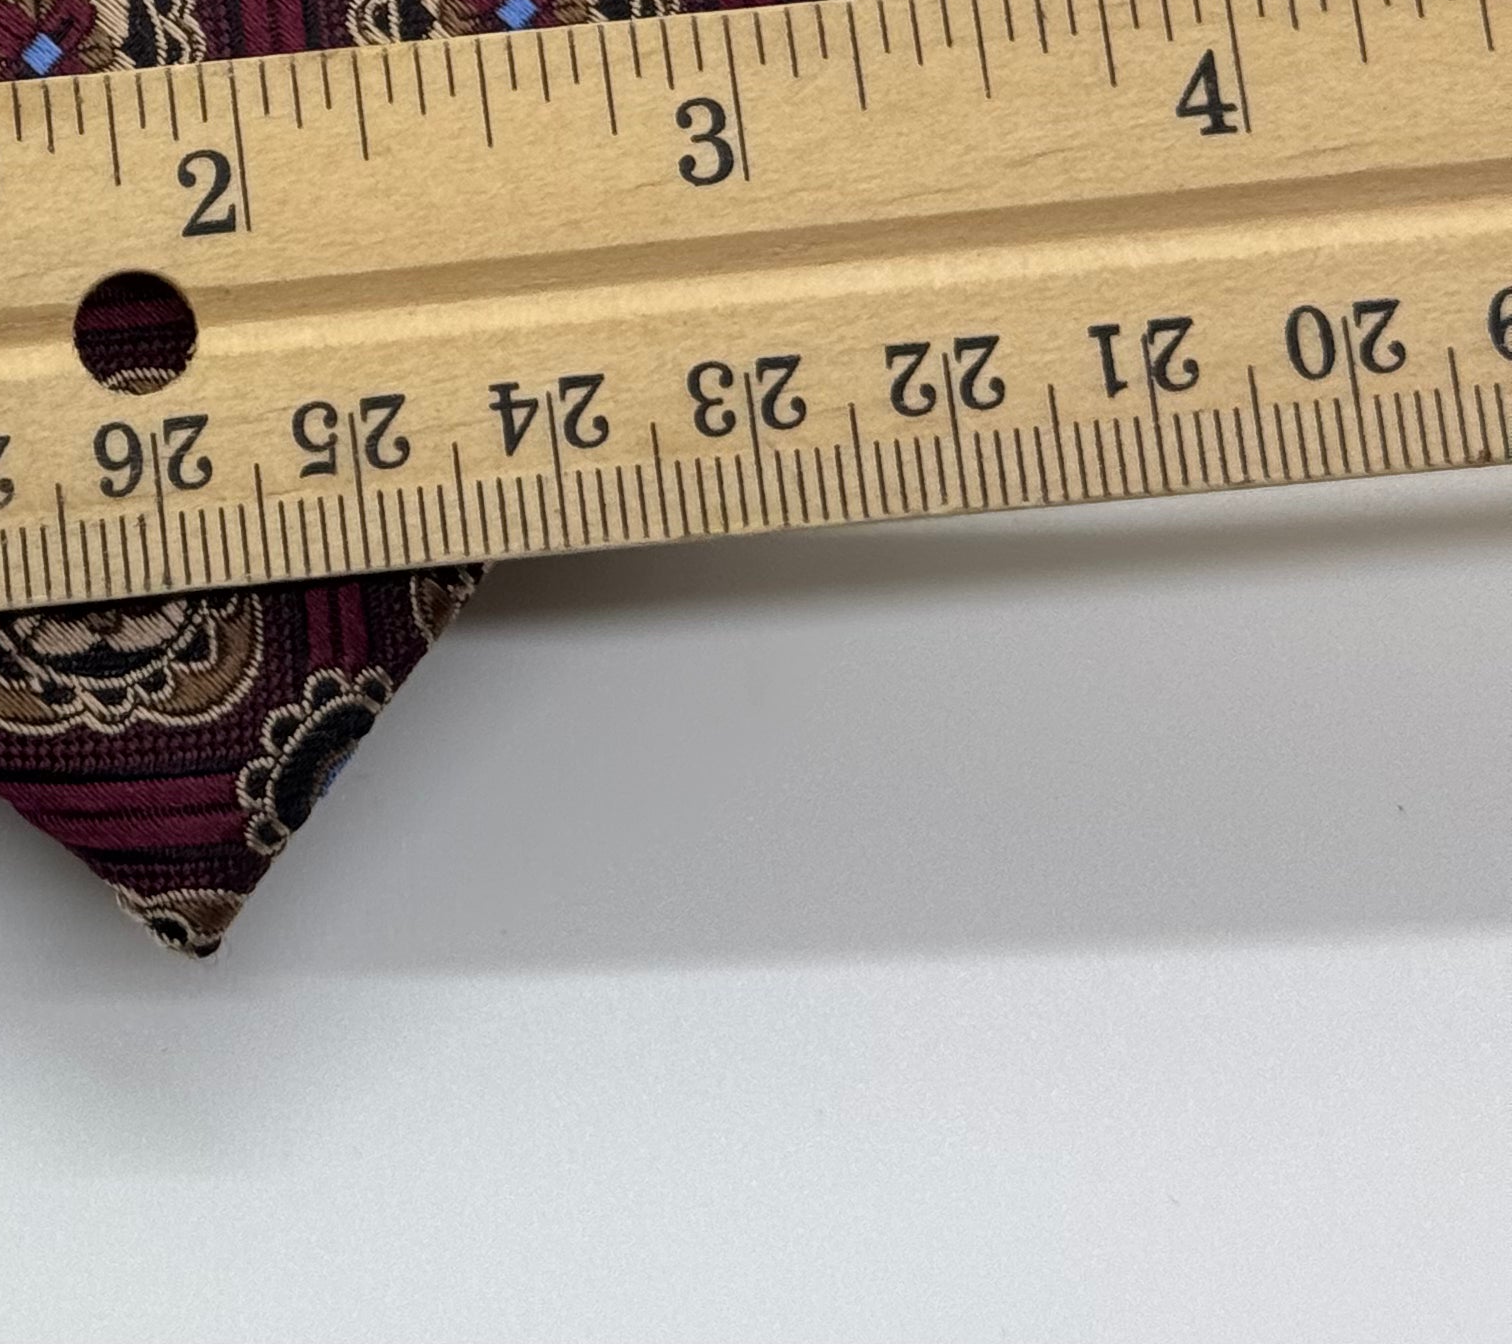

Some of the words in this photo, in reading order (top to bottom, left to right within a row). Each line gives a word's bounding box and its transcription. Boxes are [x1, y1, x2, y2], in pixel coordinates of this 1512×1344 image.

[176, 149, 237, 238] 2
[675, 96, 736, 187] 3
[1174, 48, 1240, 137] 4
[884, 334, 1008, 418] 22
[1087, 315, 1201, 399] 21
[1284, 298, 1408, 382] 20
[290, 393, 412, 479] 25
[487, 373, 611, 458] 24
[686, 354, 809, 438] 23
[91, 414, 214, 500] 26
